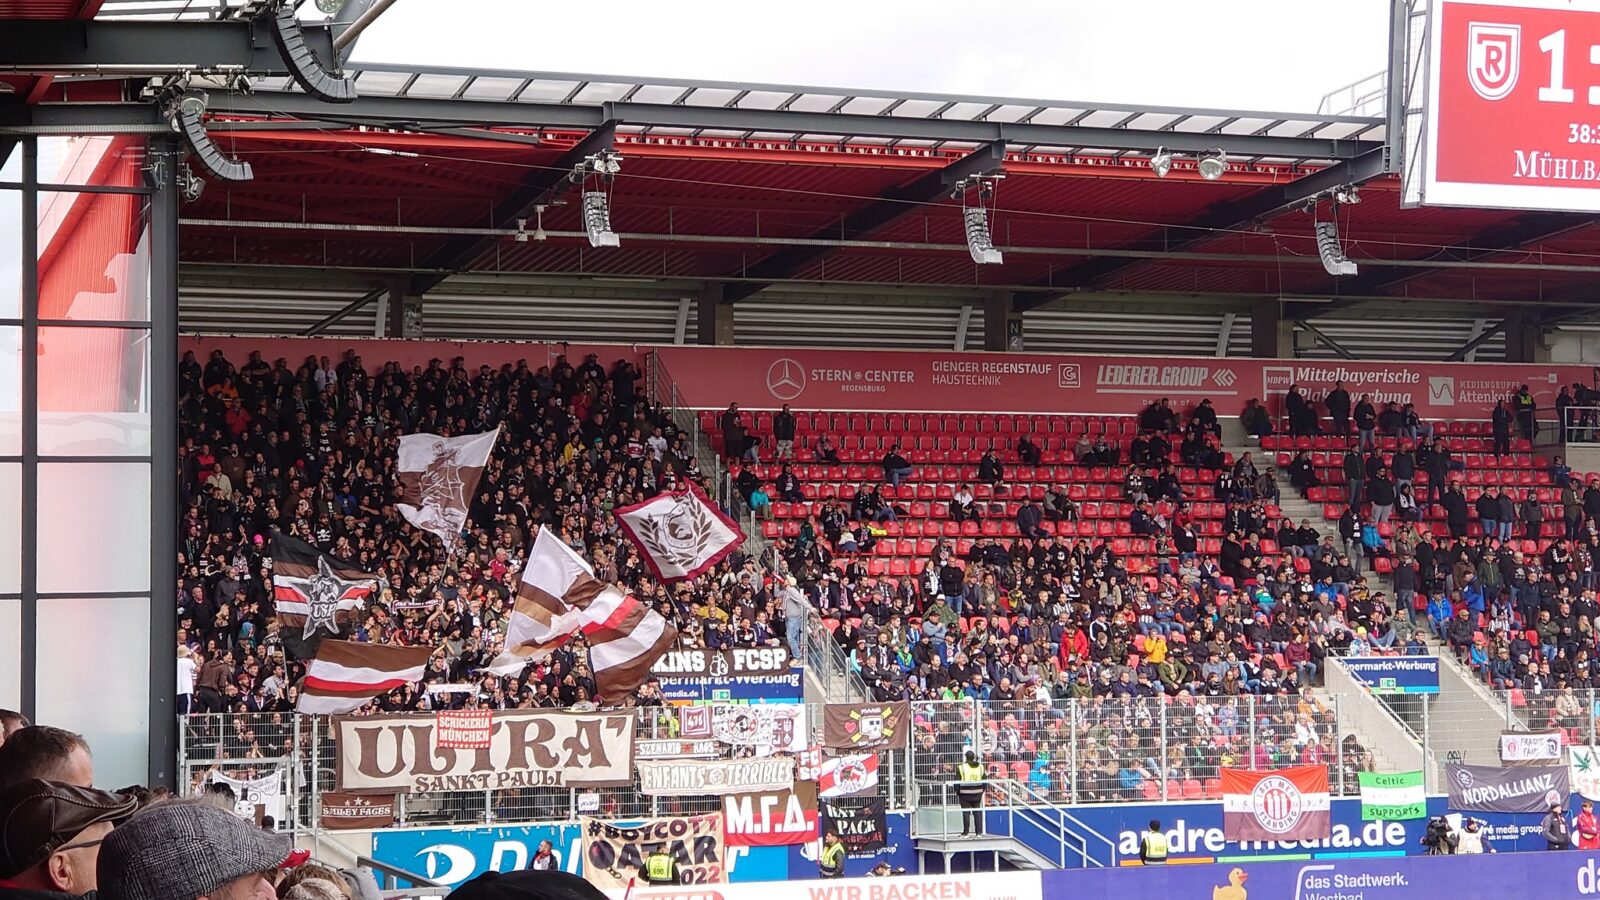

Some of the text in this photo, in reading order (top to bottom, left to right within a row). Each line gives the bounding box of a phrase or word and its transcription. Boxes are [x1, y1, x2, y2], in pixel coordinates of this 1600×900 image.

[1513, 149, 1600, 181] MÜHLB
[812, 369, 915, 383] STERN CENTER
[932, 361, 1052, 375] GIENGER REGENSTAUF
[932, 374, 1001, 386] HAUSTECHNIK
[1296, 366, 1420, 387] Mittelbayerische
[841, 384, 886, 393] REGENSBURG
[311, 601, 337, 618] USP
[651, 648, 787, 673] KINS FCSP
[438, 716, 490, 729] SCHICKERIA
[438, 728, 490, 743] MÜNCHEN
[415, 769, 563, 793] SANKT PAULI
[643, 760, 795, 789] ENFANTS TERRIBLES
[1375, 777, 1404, 785] Celtic
[1462, 773, 1555, 805] NORDALLIANZ
[1369, 806, 1420, 817] SUPPORTS
[837, 819, 876, 835] PACK
[1496, 824, 1519, 834] media
[1520, 825, 1543, 836] group
[1305, 872, 1409, 889] das Stadtwerk.
[808, 881, 971, 900] WIR BACKEN
